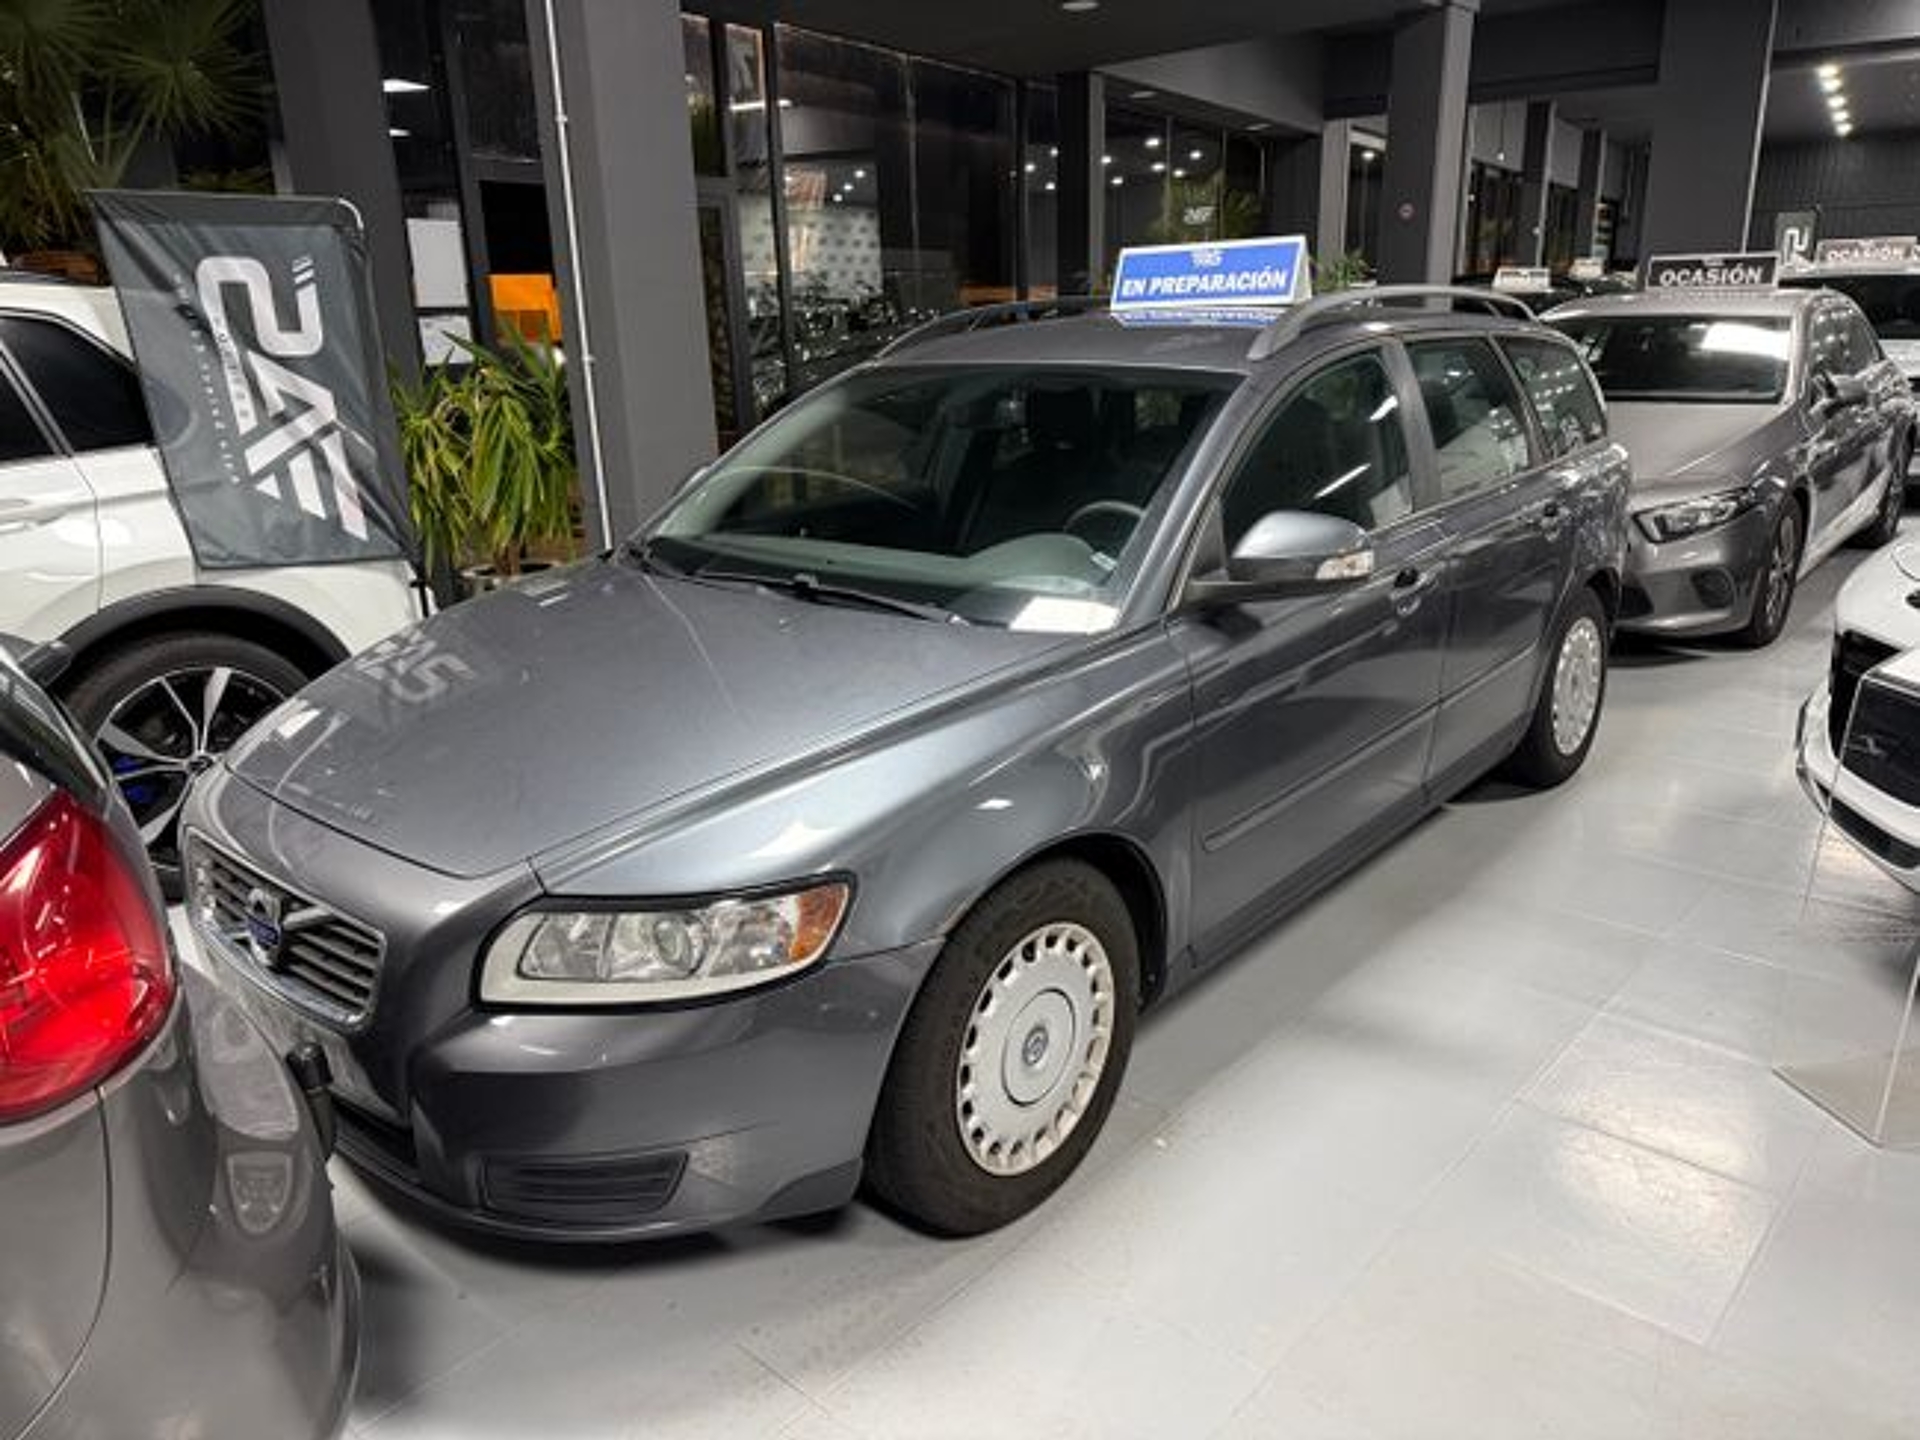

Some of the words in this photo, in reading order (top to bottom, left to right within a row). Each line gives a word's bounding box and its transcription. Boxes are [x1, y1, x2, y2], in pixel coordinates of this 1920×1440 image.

[1121, 276, 1147, 297] EN
[1148, 264, 1288, 296] PREPARACIÓN
[1659, 261, 1763, 287] OCASIÓN
